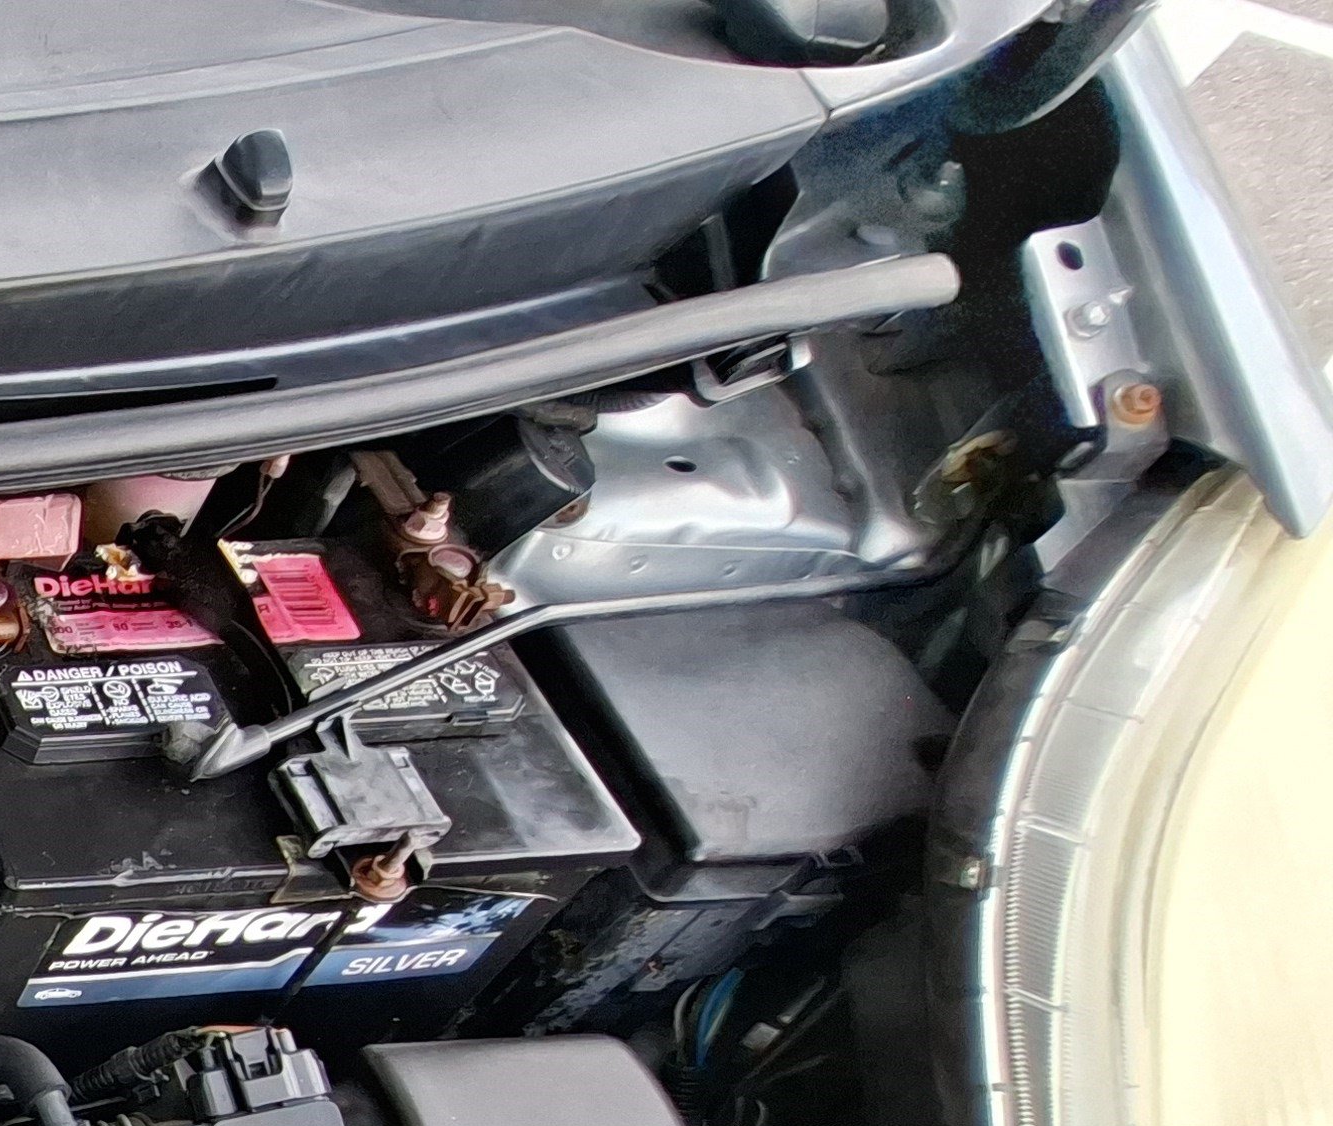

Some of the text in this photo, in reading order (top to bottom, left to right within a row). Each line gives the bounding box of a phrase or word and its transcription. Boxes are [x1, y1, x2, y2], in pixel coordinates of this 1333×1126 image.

[34, 574, 153, 597] DieHar
[33, 666, 103, 681] DANGER
[118, 661, 183, 676] POISON
[114, 698, 129, 706] NO
[48, 951, 209, 971] POWER AHEAD
[341, 949, 468, 976] SILVER
